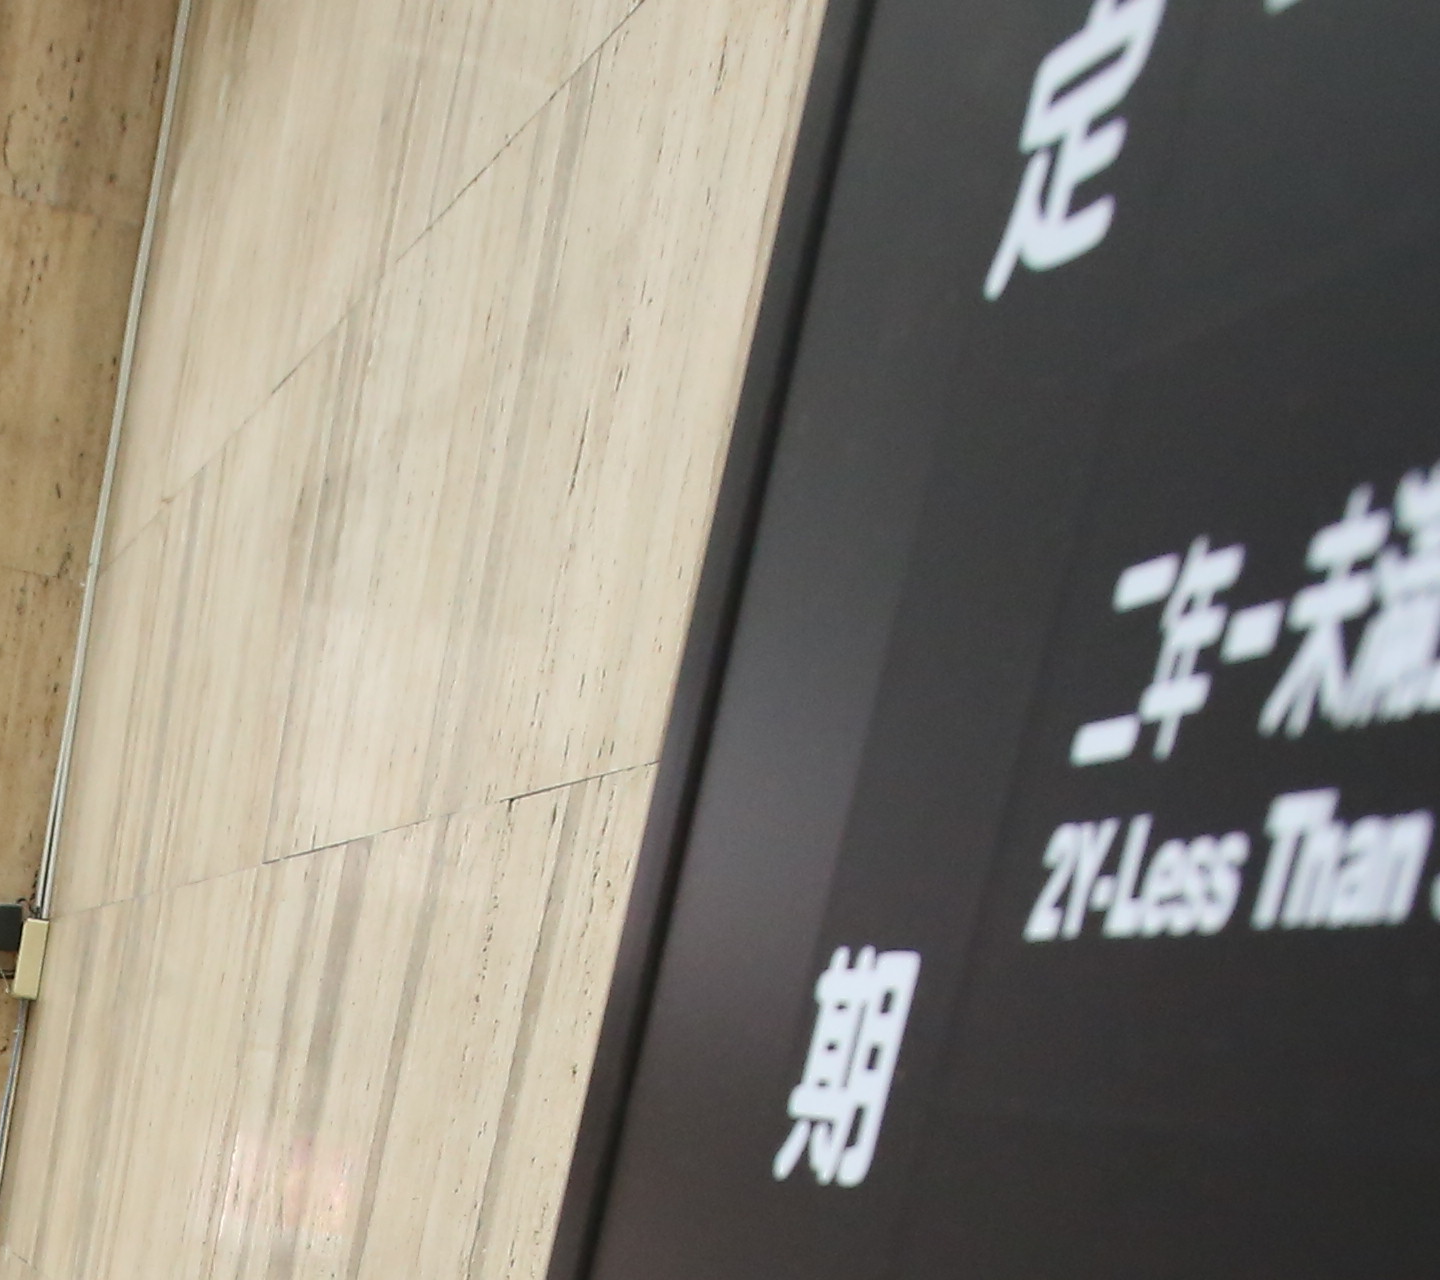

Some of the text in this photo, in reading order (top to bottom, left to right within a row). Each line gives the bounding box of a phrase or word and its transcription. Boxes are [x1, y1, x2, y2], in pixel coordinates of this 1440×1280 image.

[1023, 812, 1248, 943] 2Y-Less
[1251, 787, 1434, 931] Than
[773, 947, 921, 1187] 期
